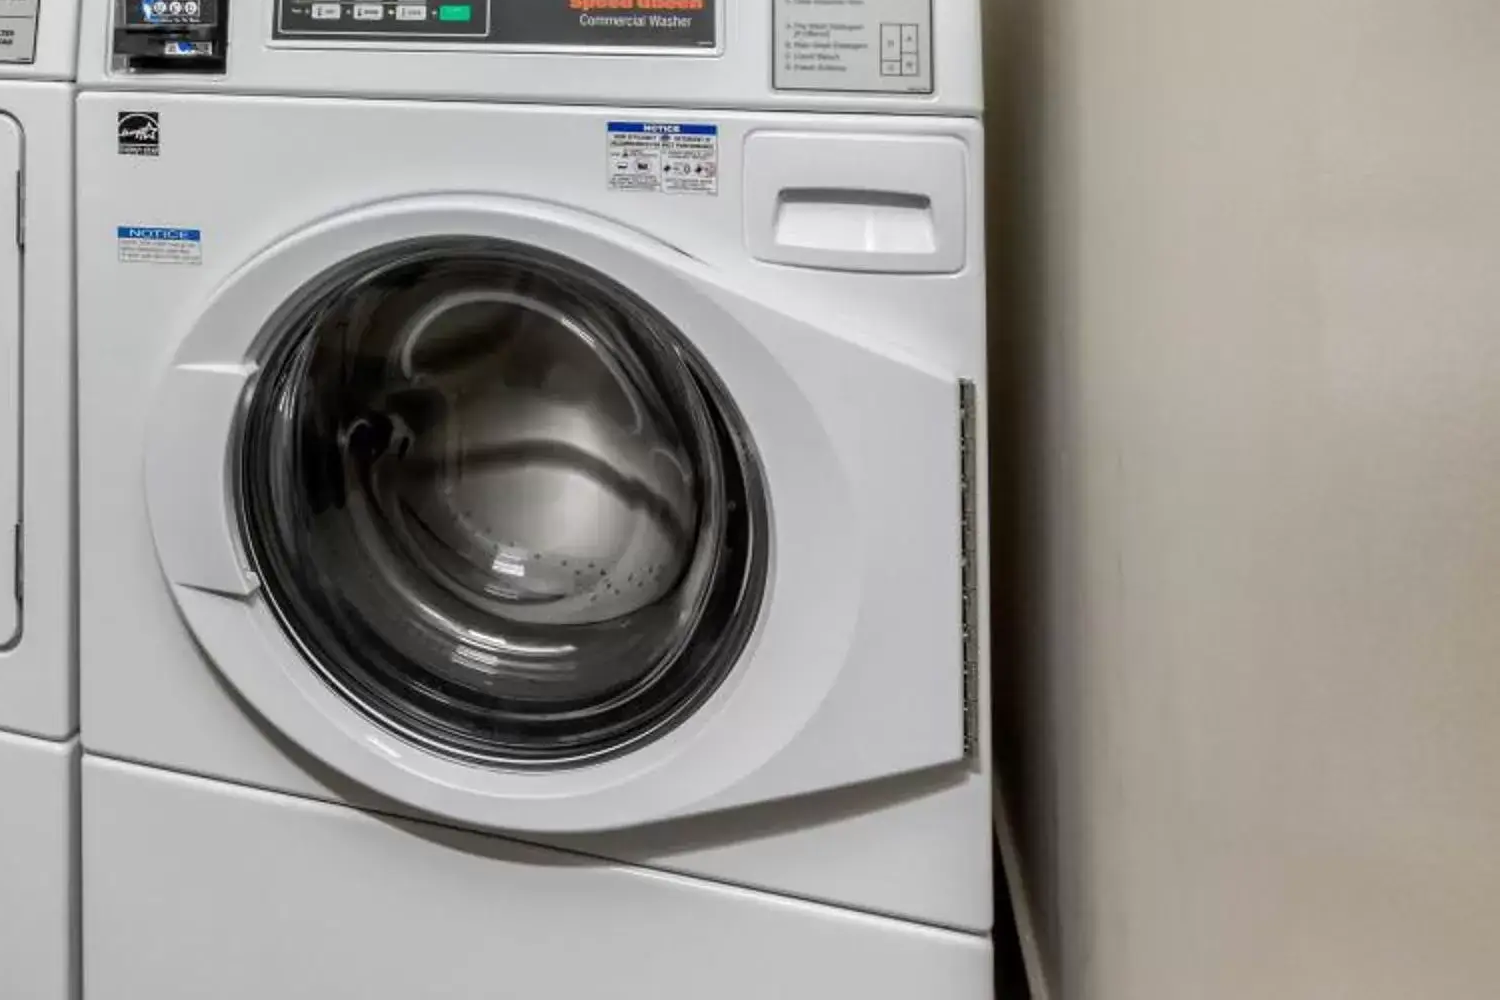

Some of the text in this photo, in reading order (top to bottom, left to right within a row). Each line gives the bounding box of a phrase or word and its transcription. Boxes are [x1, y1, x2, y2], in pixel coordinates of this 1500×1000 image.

[579, 13, 693, 28] Commercial Washer
[643, 124, 681, 133] NOTICE
[128, 228, 189, 239] NOTICE
